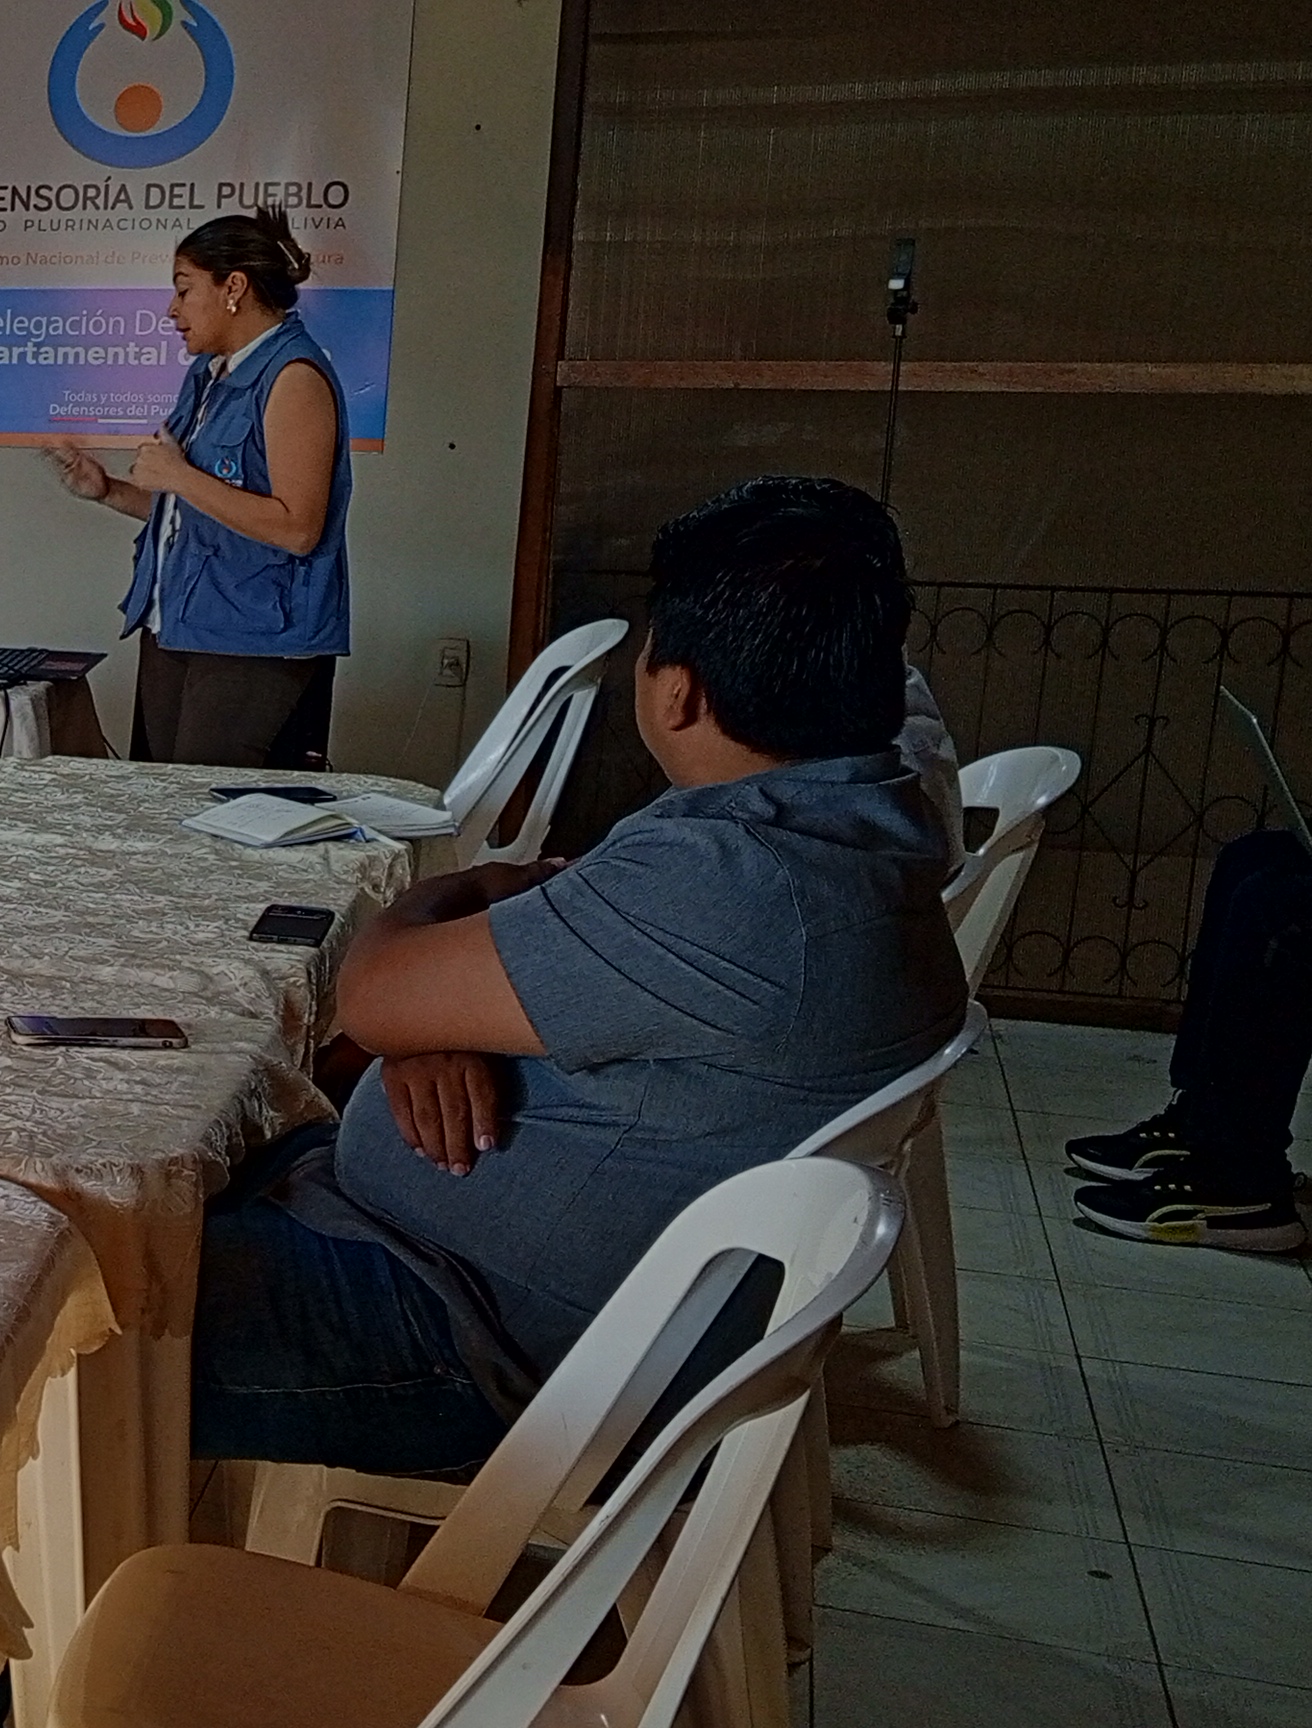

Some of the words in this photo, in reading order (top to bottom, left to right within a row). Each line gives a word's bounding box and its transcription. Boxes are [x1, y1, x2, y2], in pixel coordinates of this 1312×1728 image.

[144, 182, 206, 210] DEL
[216, 180, 350, 210] PUEBLO
[24, 217, 195, 232] PLURINACIONAL
[291, 217, 347, 230] LIVIA
[25, 250, 99, 266] Nacional
[104, 250, 126, 265] de
[62, 390, 98, 402] Todas
[100, 393, 108, 404] y
[110, 390, 145, 403] todos
[49, 403, 124, 416] Defensores
[126, 404, 148, 416] del
